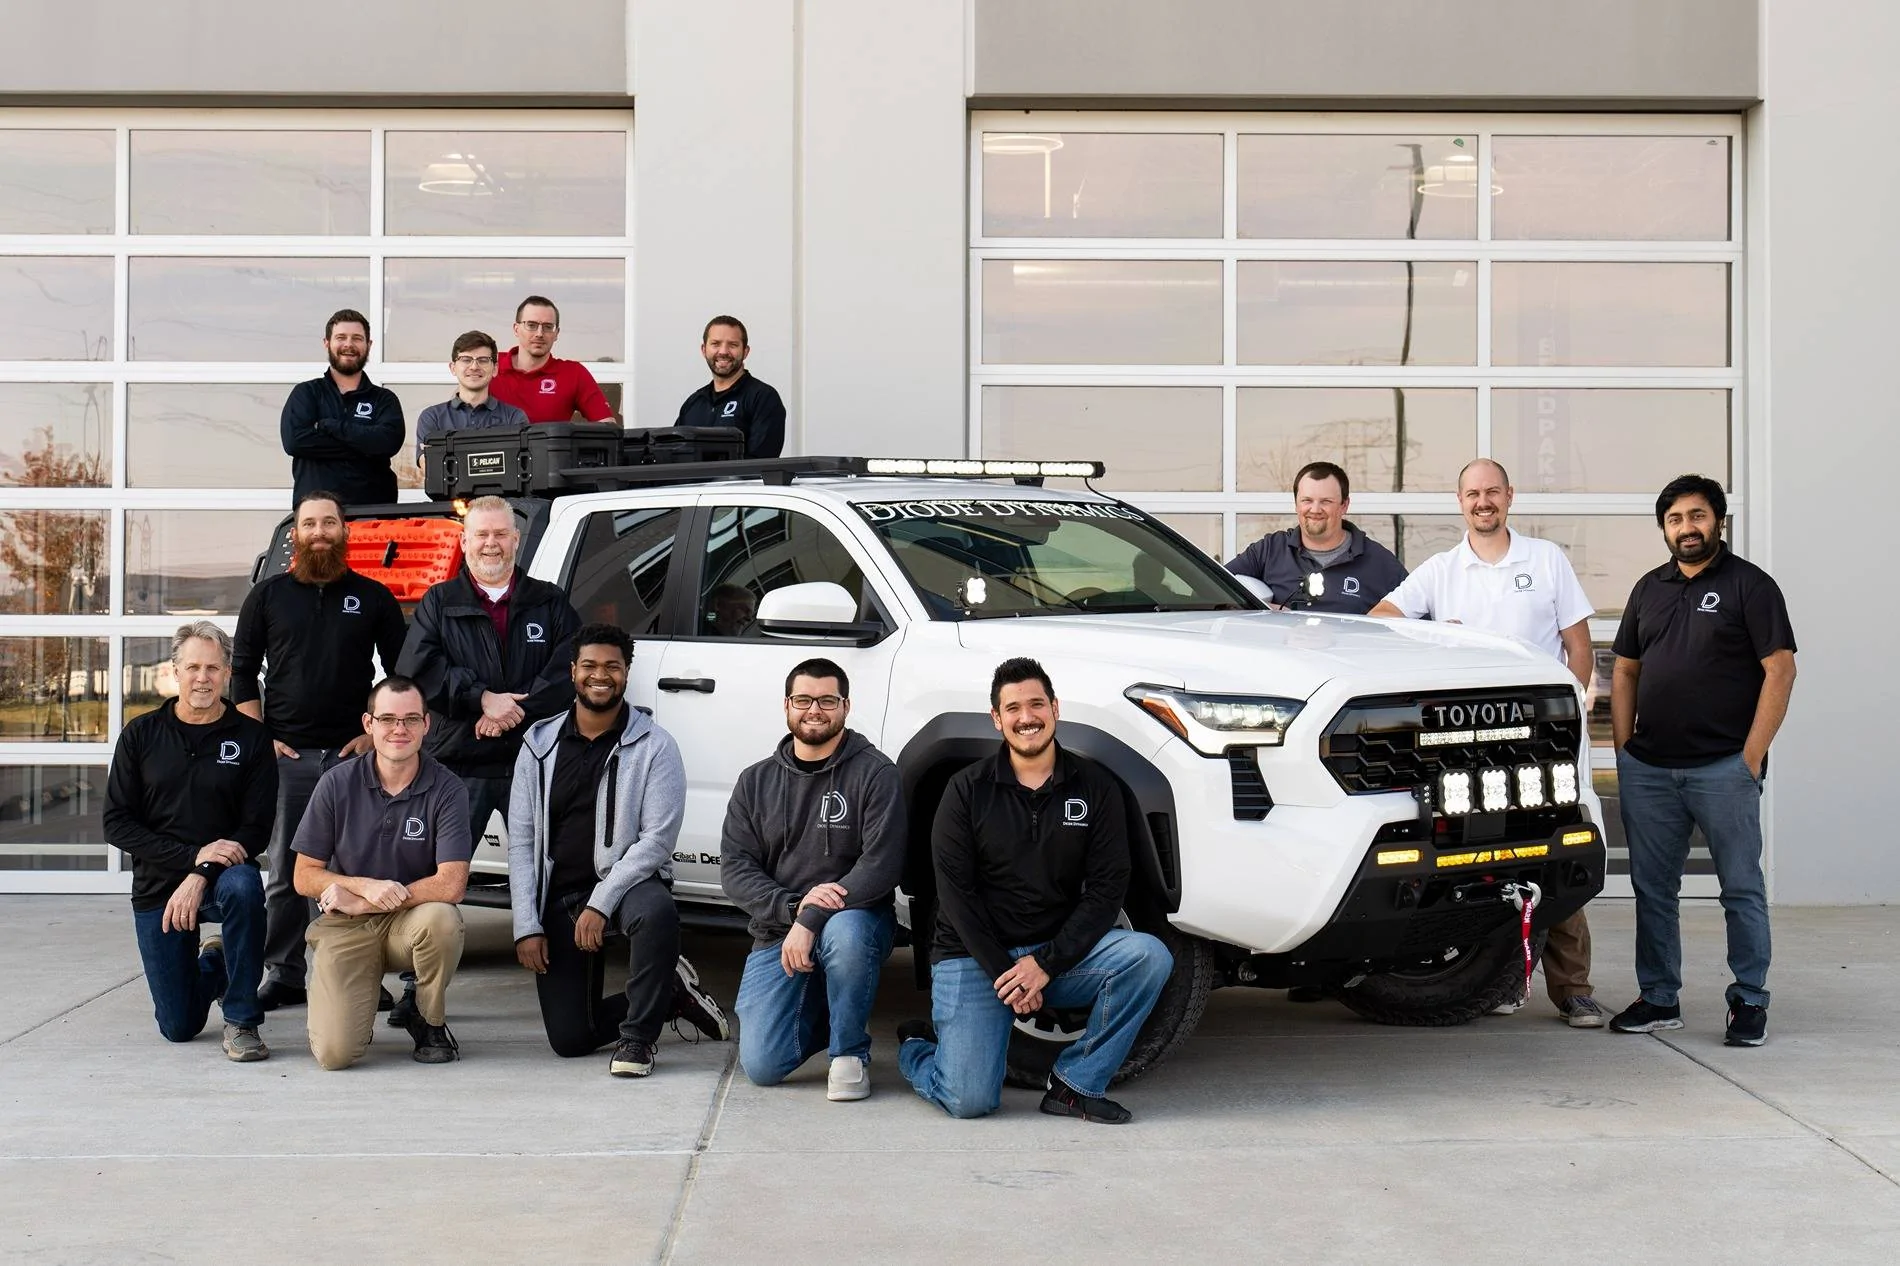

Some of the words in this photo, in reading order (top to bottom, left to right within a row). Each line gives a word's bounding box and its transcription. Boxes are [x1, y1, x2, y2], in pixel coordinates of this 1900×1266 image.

[480, 457, 501, 466] PELICAN
[855, 500, 983, 520] DIODE
[976, 500, 1145, 521] DYNAMICS
[1434, 701, 1524, 726] TOYOTA
[700, 852, 722, 865] DEE
